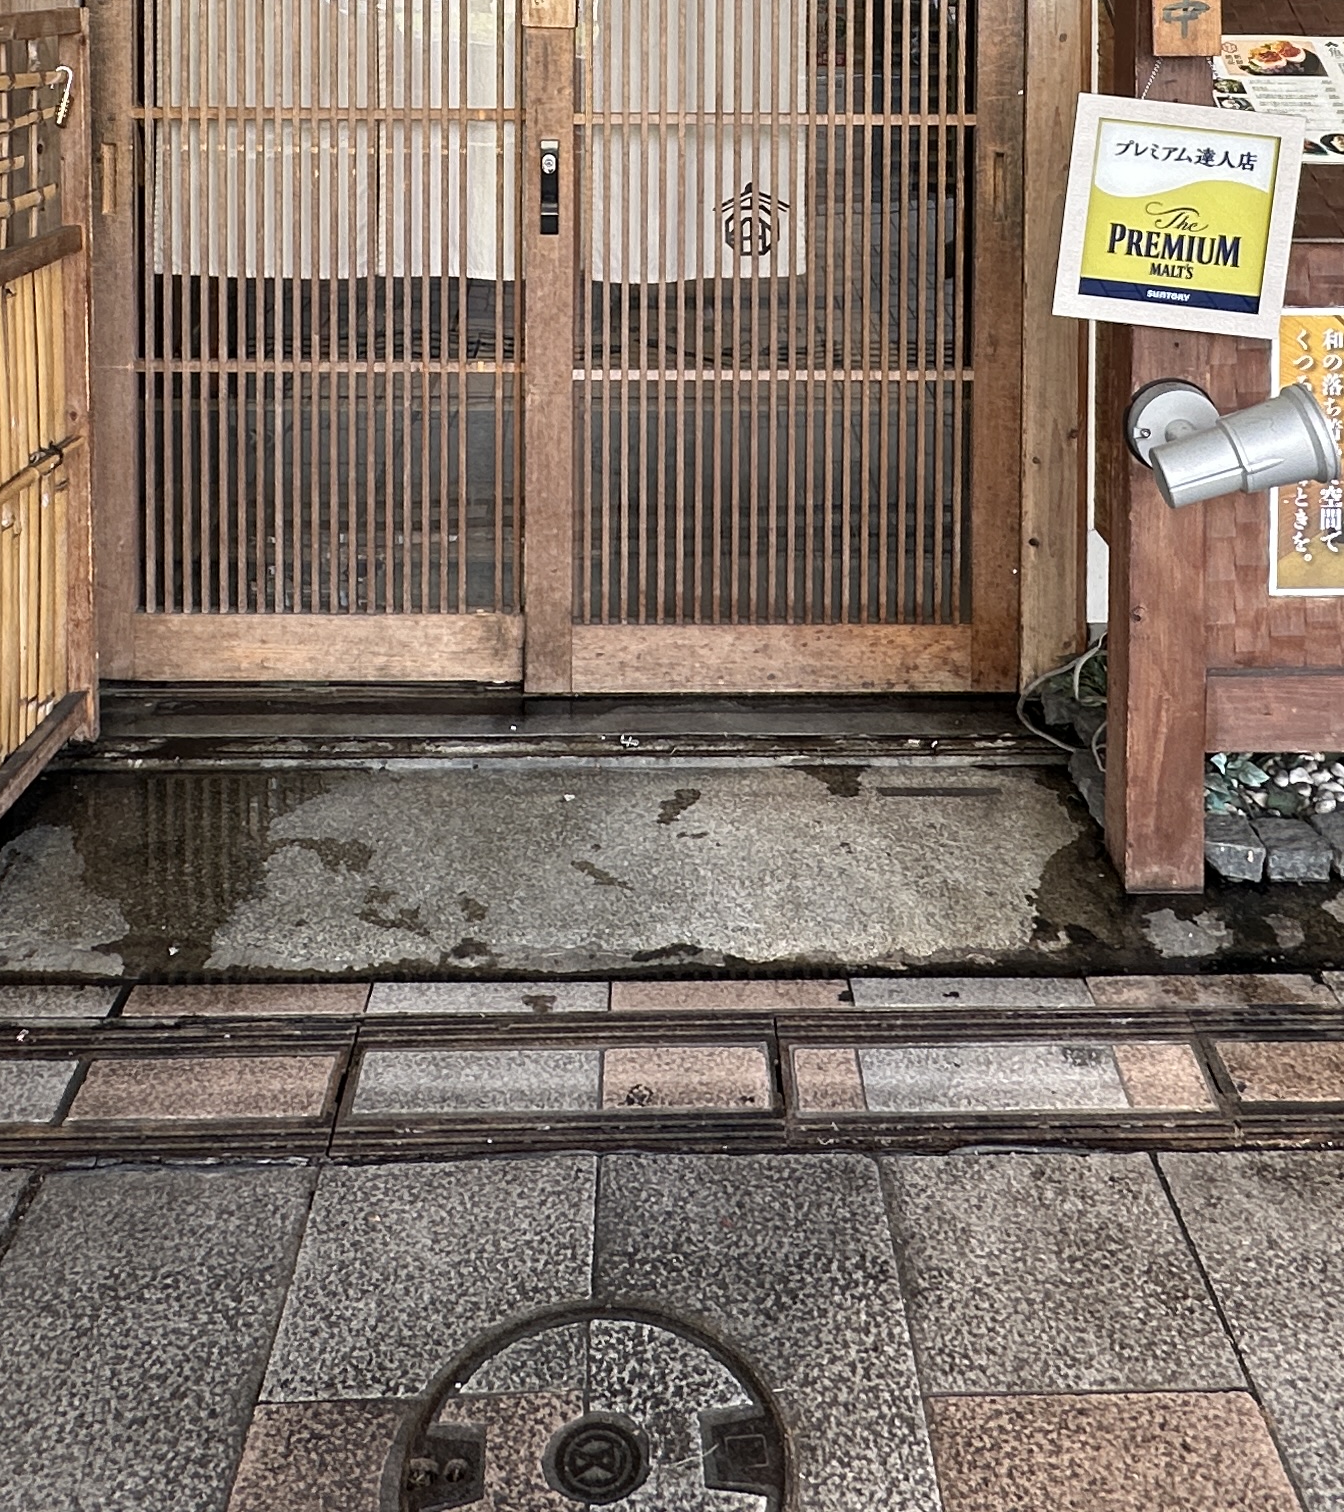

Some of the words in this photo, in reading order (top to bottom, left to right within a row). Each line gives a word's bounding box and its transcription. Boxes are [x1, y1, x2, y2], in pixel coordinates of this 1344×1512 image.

[1114, 139, 1258, 171] プレミアム達人店
[1145, 201, 1209, 232] The
[1106, 222, 1242, 268] PREMIUM
[1149, 262, 1194, 280] MALT'S
[1146, 289, 1191, 302] SUNTORY
